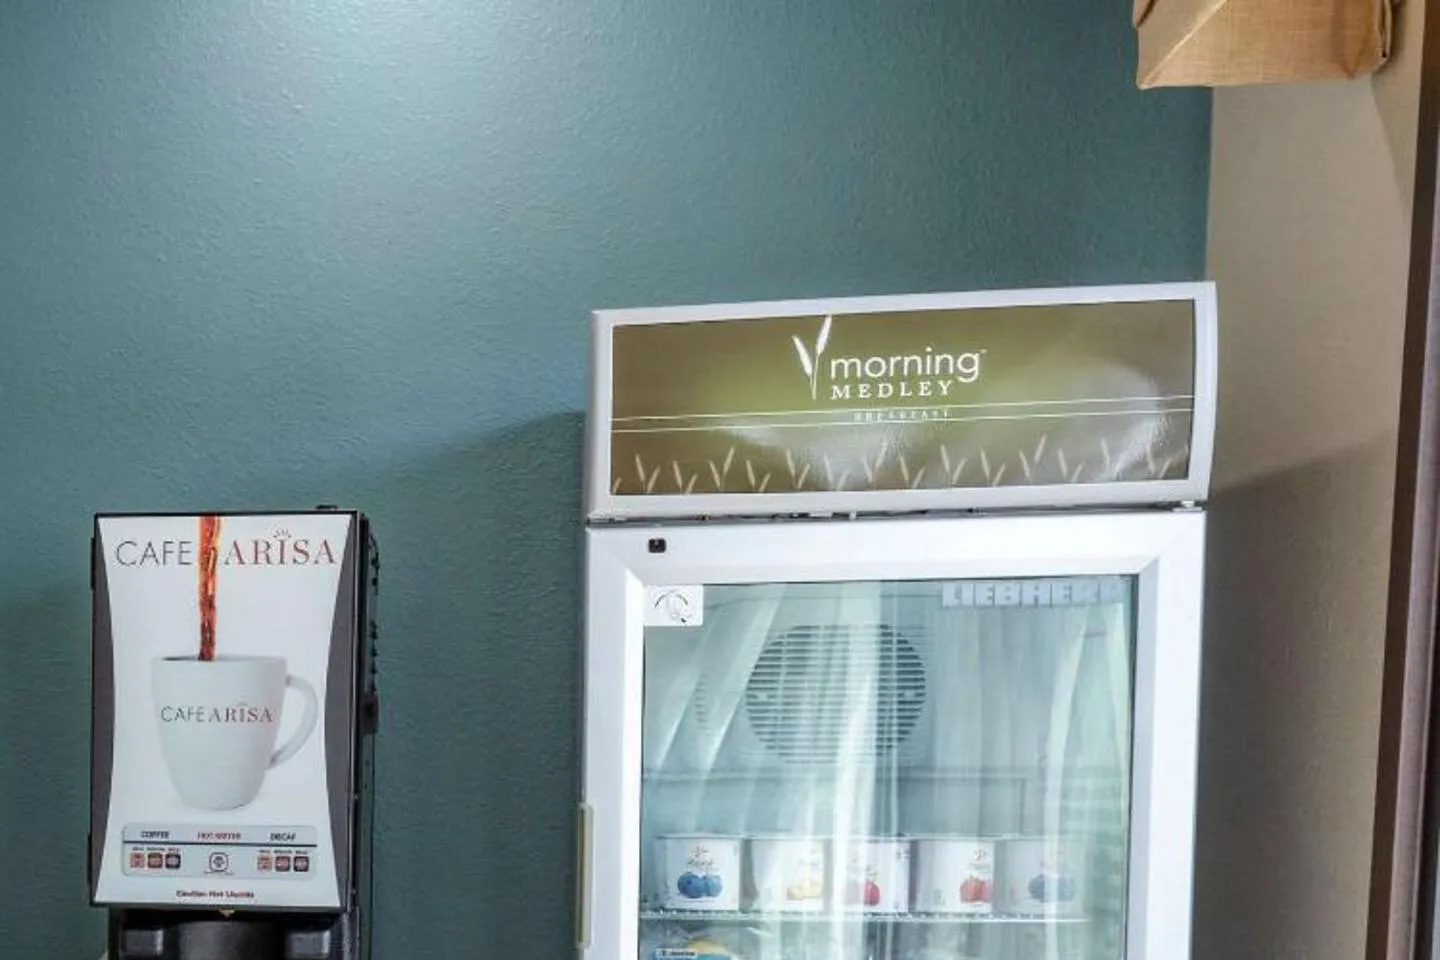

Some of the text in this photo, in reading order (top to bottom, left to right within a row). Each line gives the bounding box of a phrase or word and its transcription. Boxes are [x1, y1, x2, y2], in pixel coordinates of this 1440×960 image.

[830, 346, 980, 383] morning
[830, 380, 953, 400] MEDLEY
[115, 541, 192, 567] CAFE
